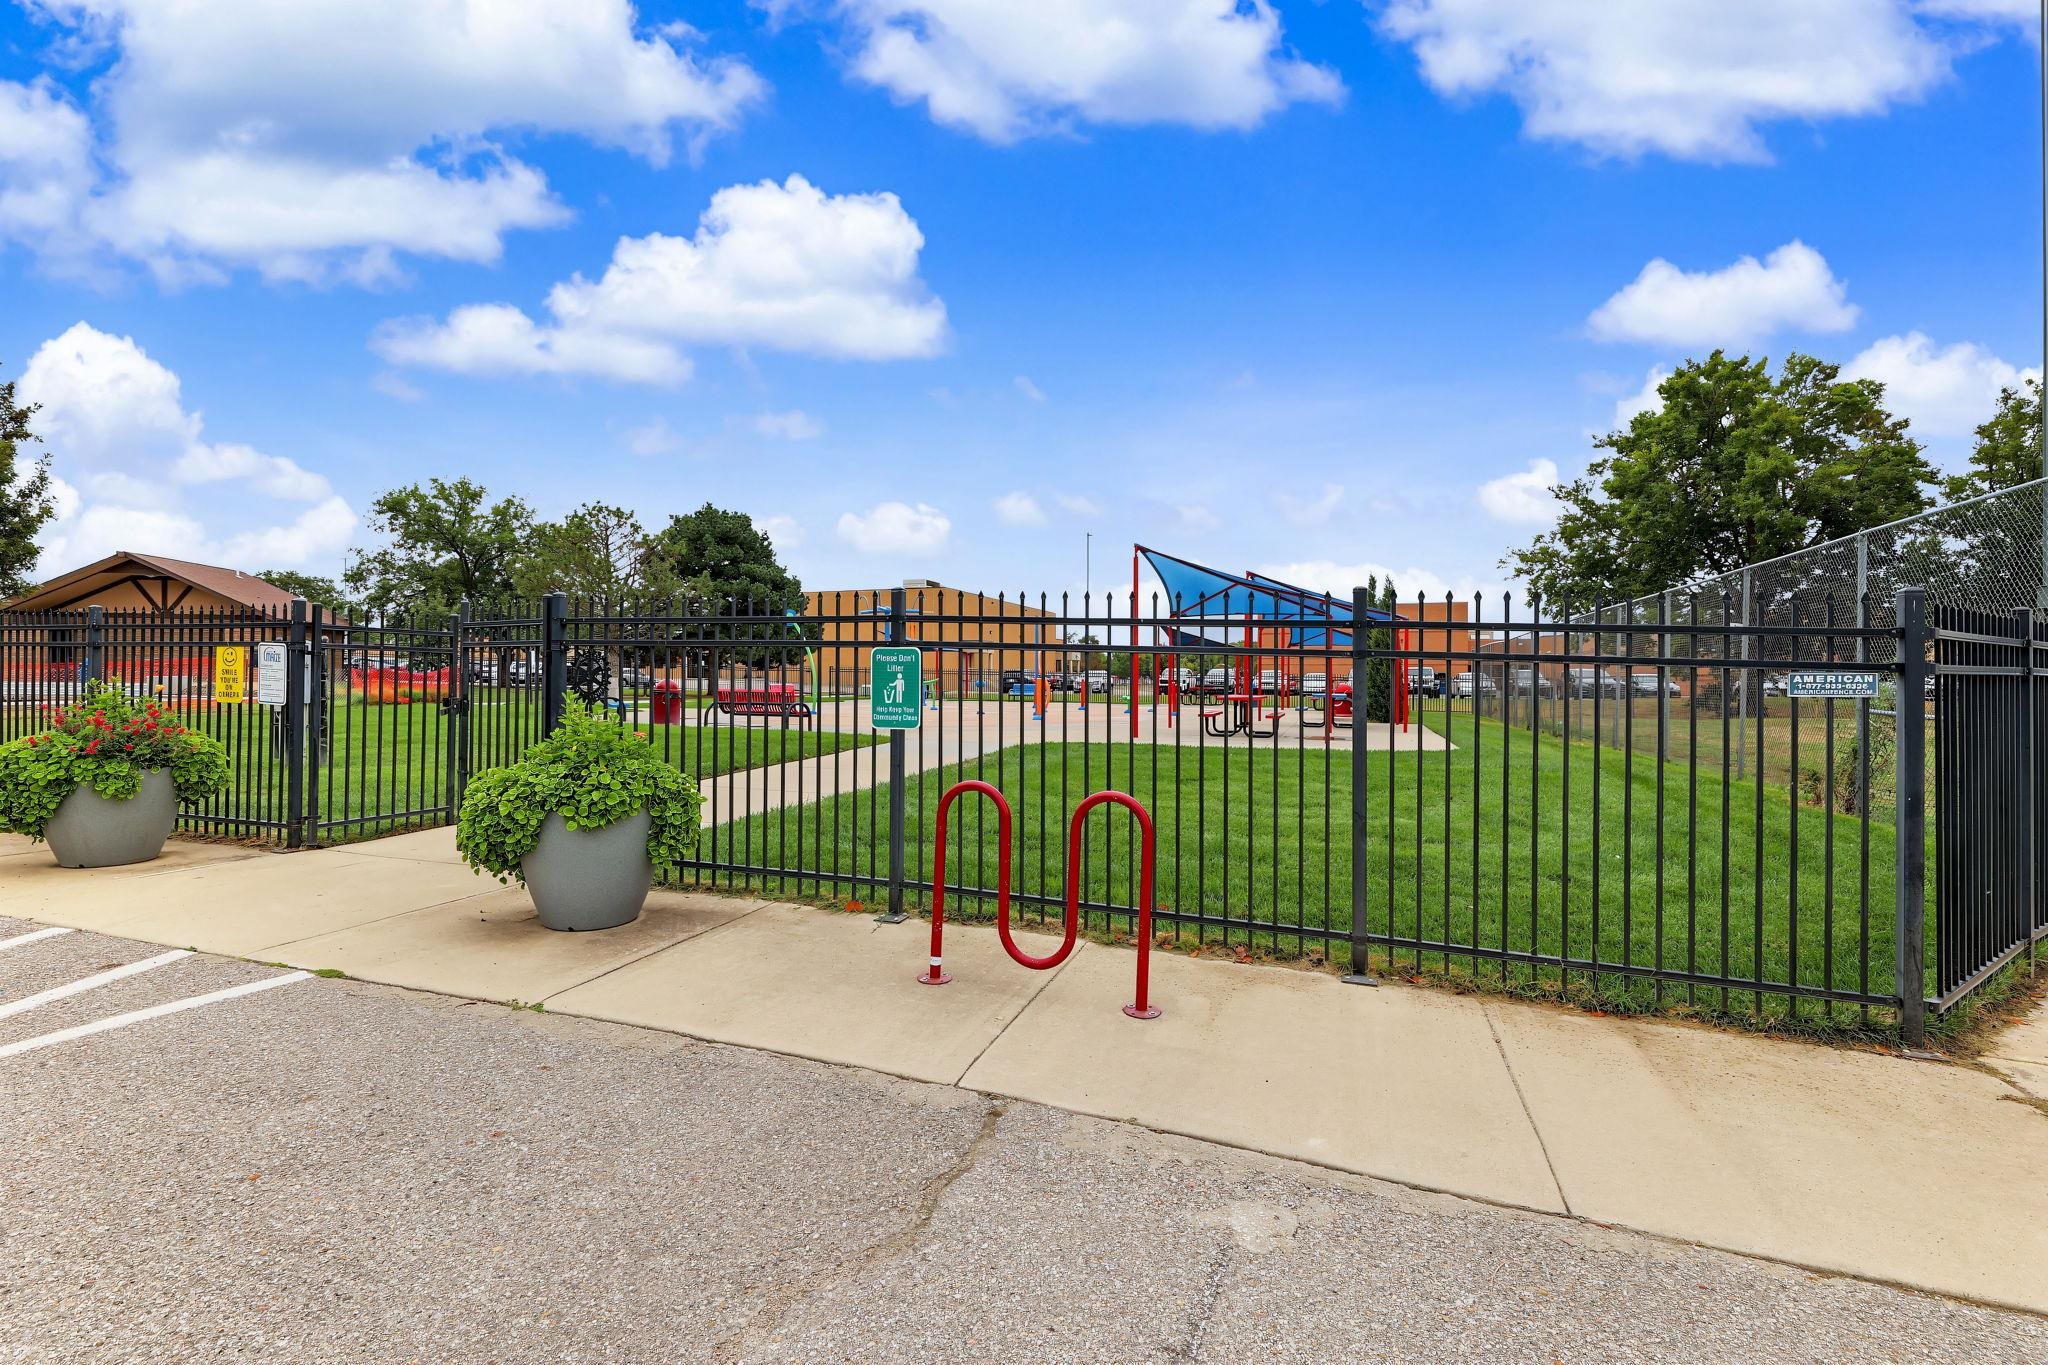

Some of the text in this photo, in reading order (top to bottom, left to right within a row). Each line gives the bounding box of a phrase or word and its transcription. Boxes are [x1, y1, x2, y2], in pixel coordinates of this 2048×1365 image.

[876, 654, 915, 662] Please Don't
[222, 668, 237, 676] SMILE
[887, 664, 904, 672] Litter
[1793, 675, 1874, 683] AMERICAN
[889, 706, 903, 714] Keep
